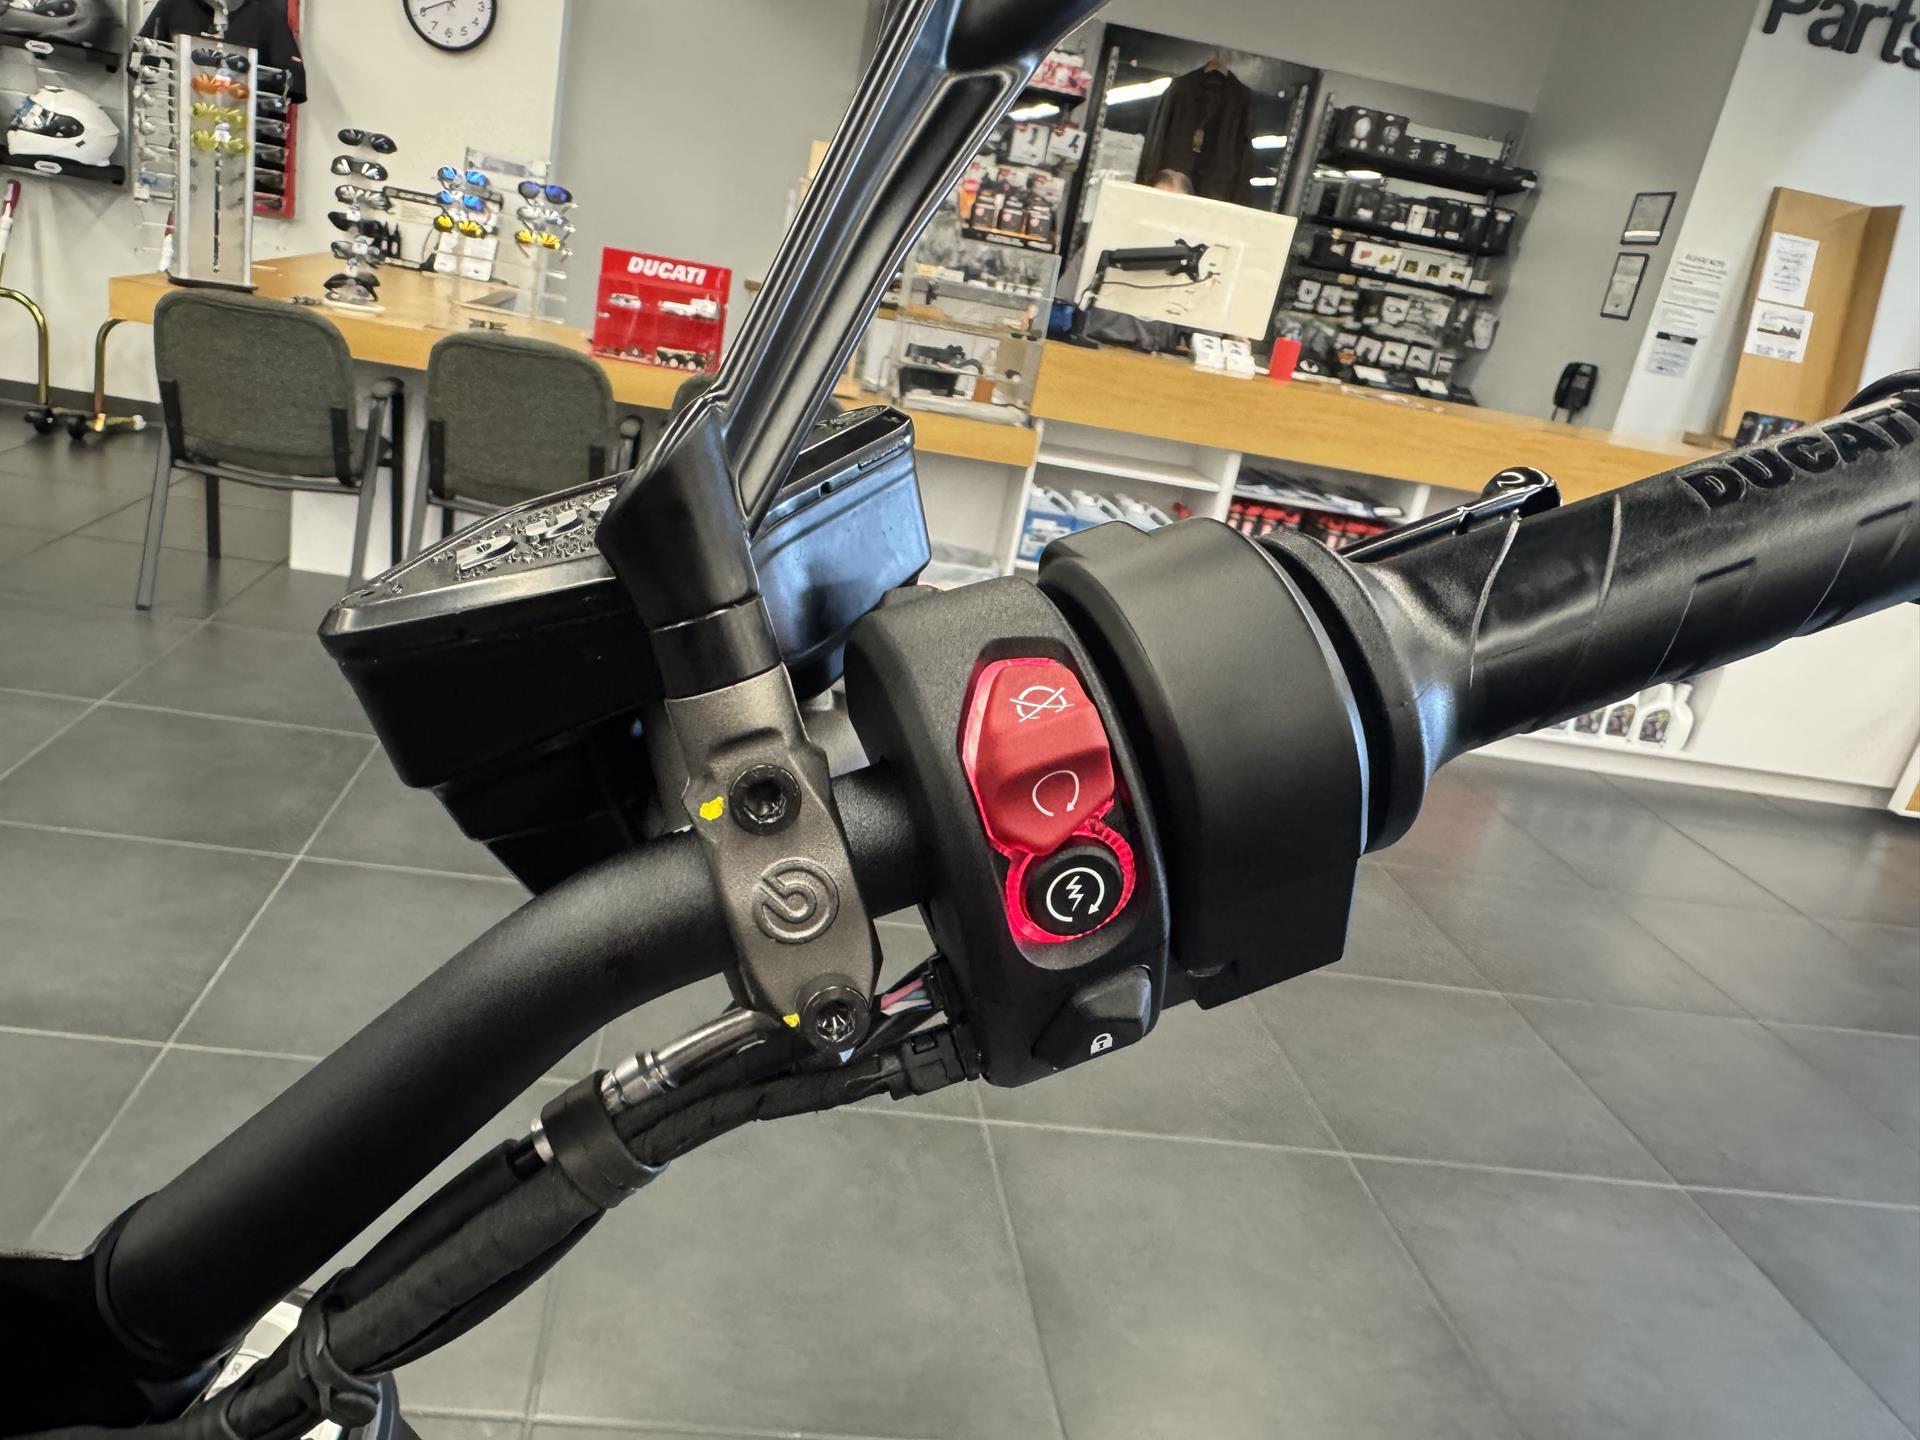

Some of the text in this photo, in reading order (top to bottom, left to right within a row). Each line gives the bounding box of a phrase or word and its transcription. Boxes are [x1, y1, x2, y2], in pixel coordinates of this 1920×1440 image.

[431, 20, 439, 30] 7
[460, 26, 468, 36] 5
[627, 256, 707, 285] DUCATI
